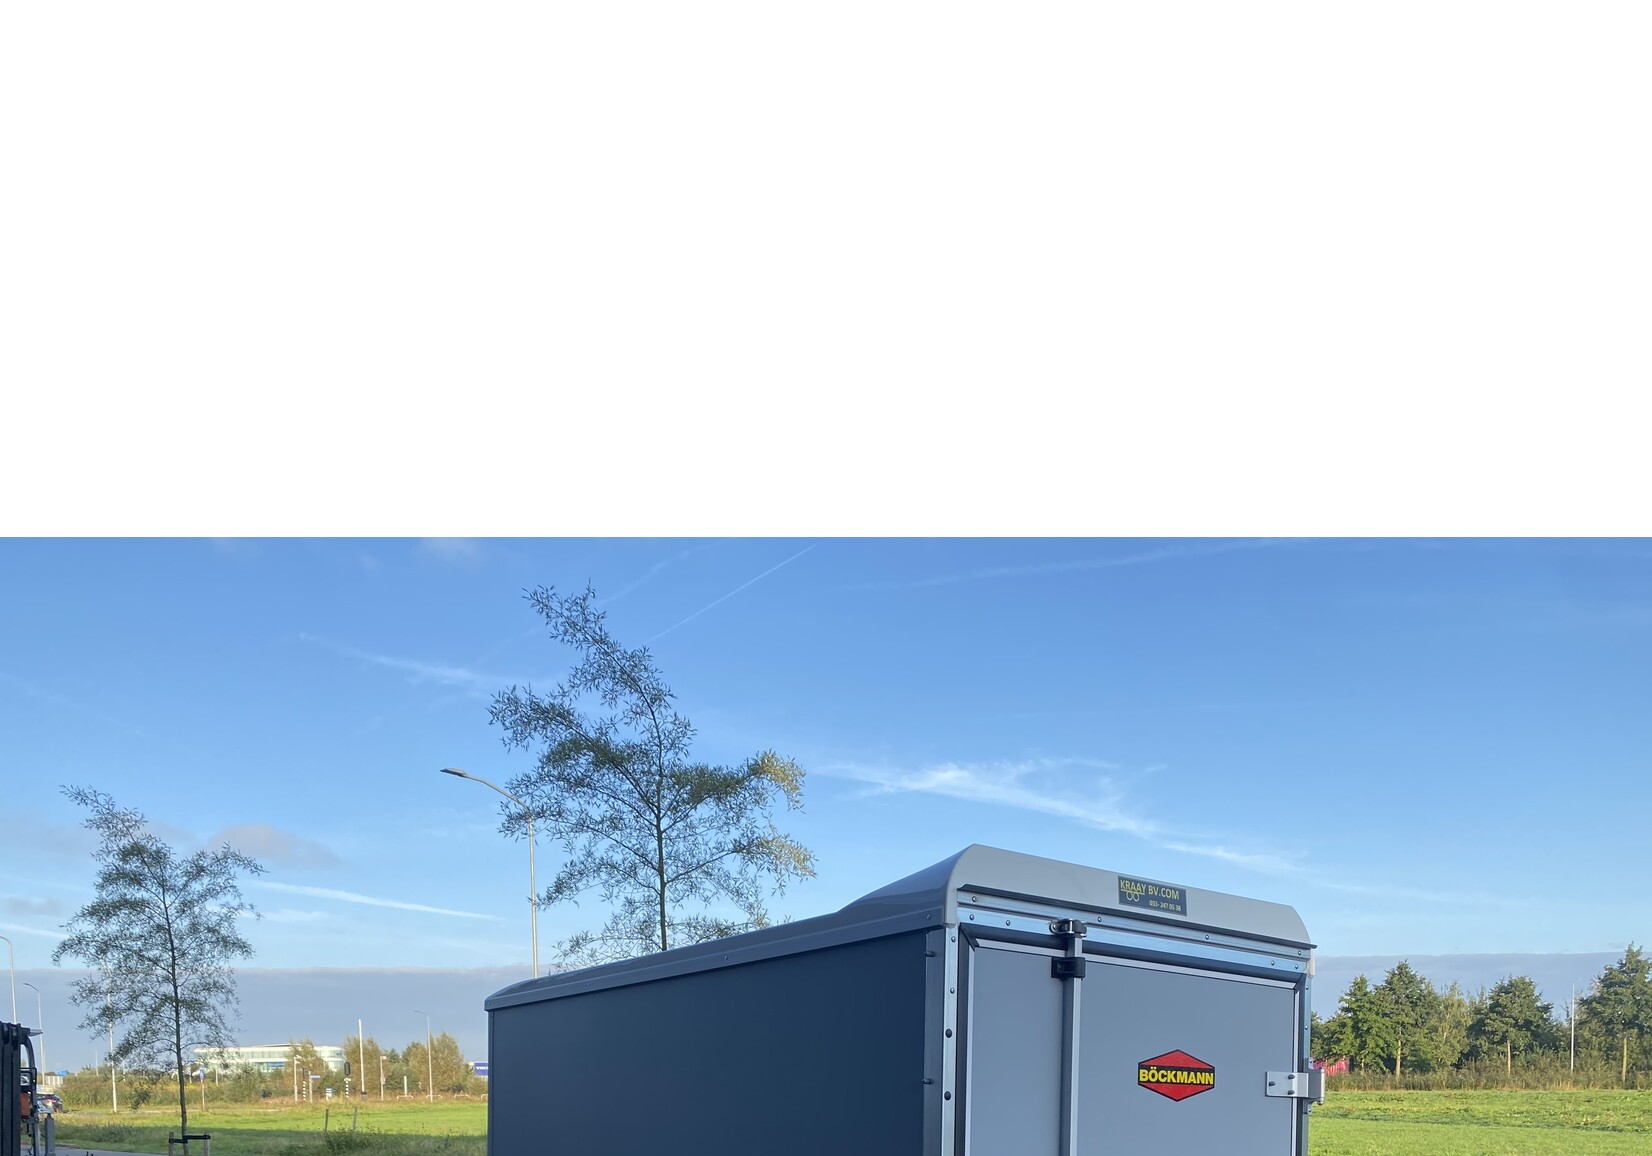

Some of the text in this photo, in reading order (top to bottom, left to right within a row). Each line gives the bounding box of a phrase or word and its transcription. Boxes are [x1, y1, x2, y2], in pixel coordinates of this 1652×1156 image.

[1120, 880, 1180, 900] KRAAY BV.COM
[1139, 1066, 1214, 1085] BÖCKMANN
